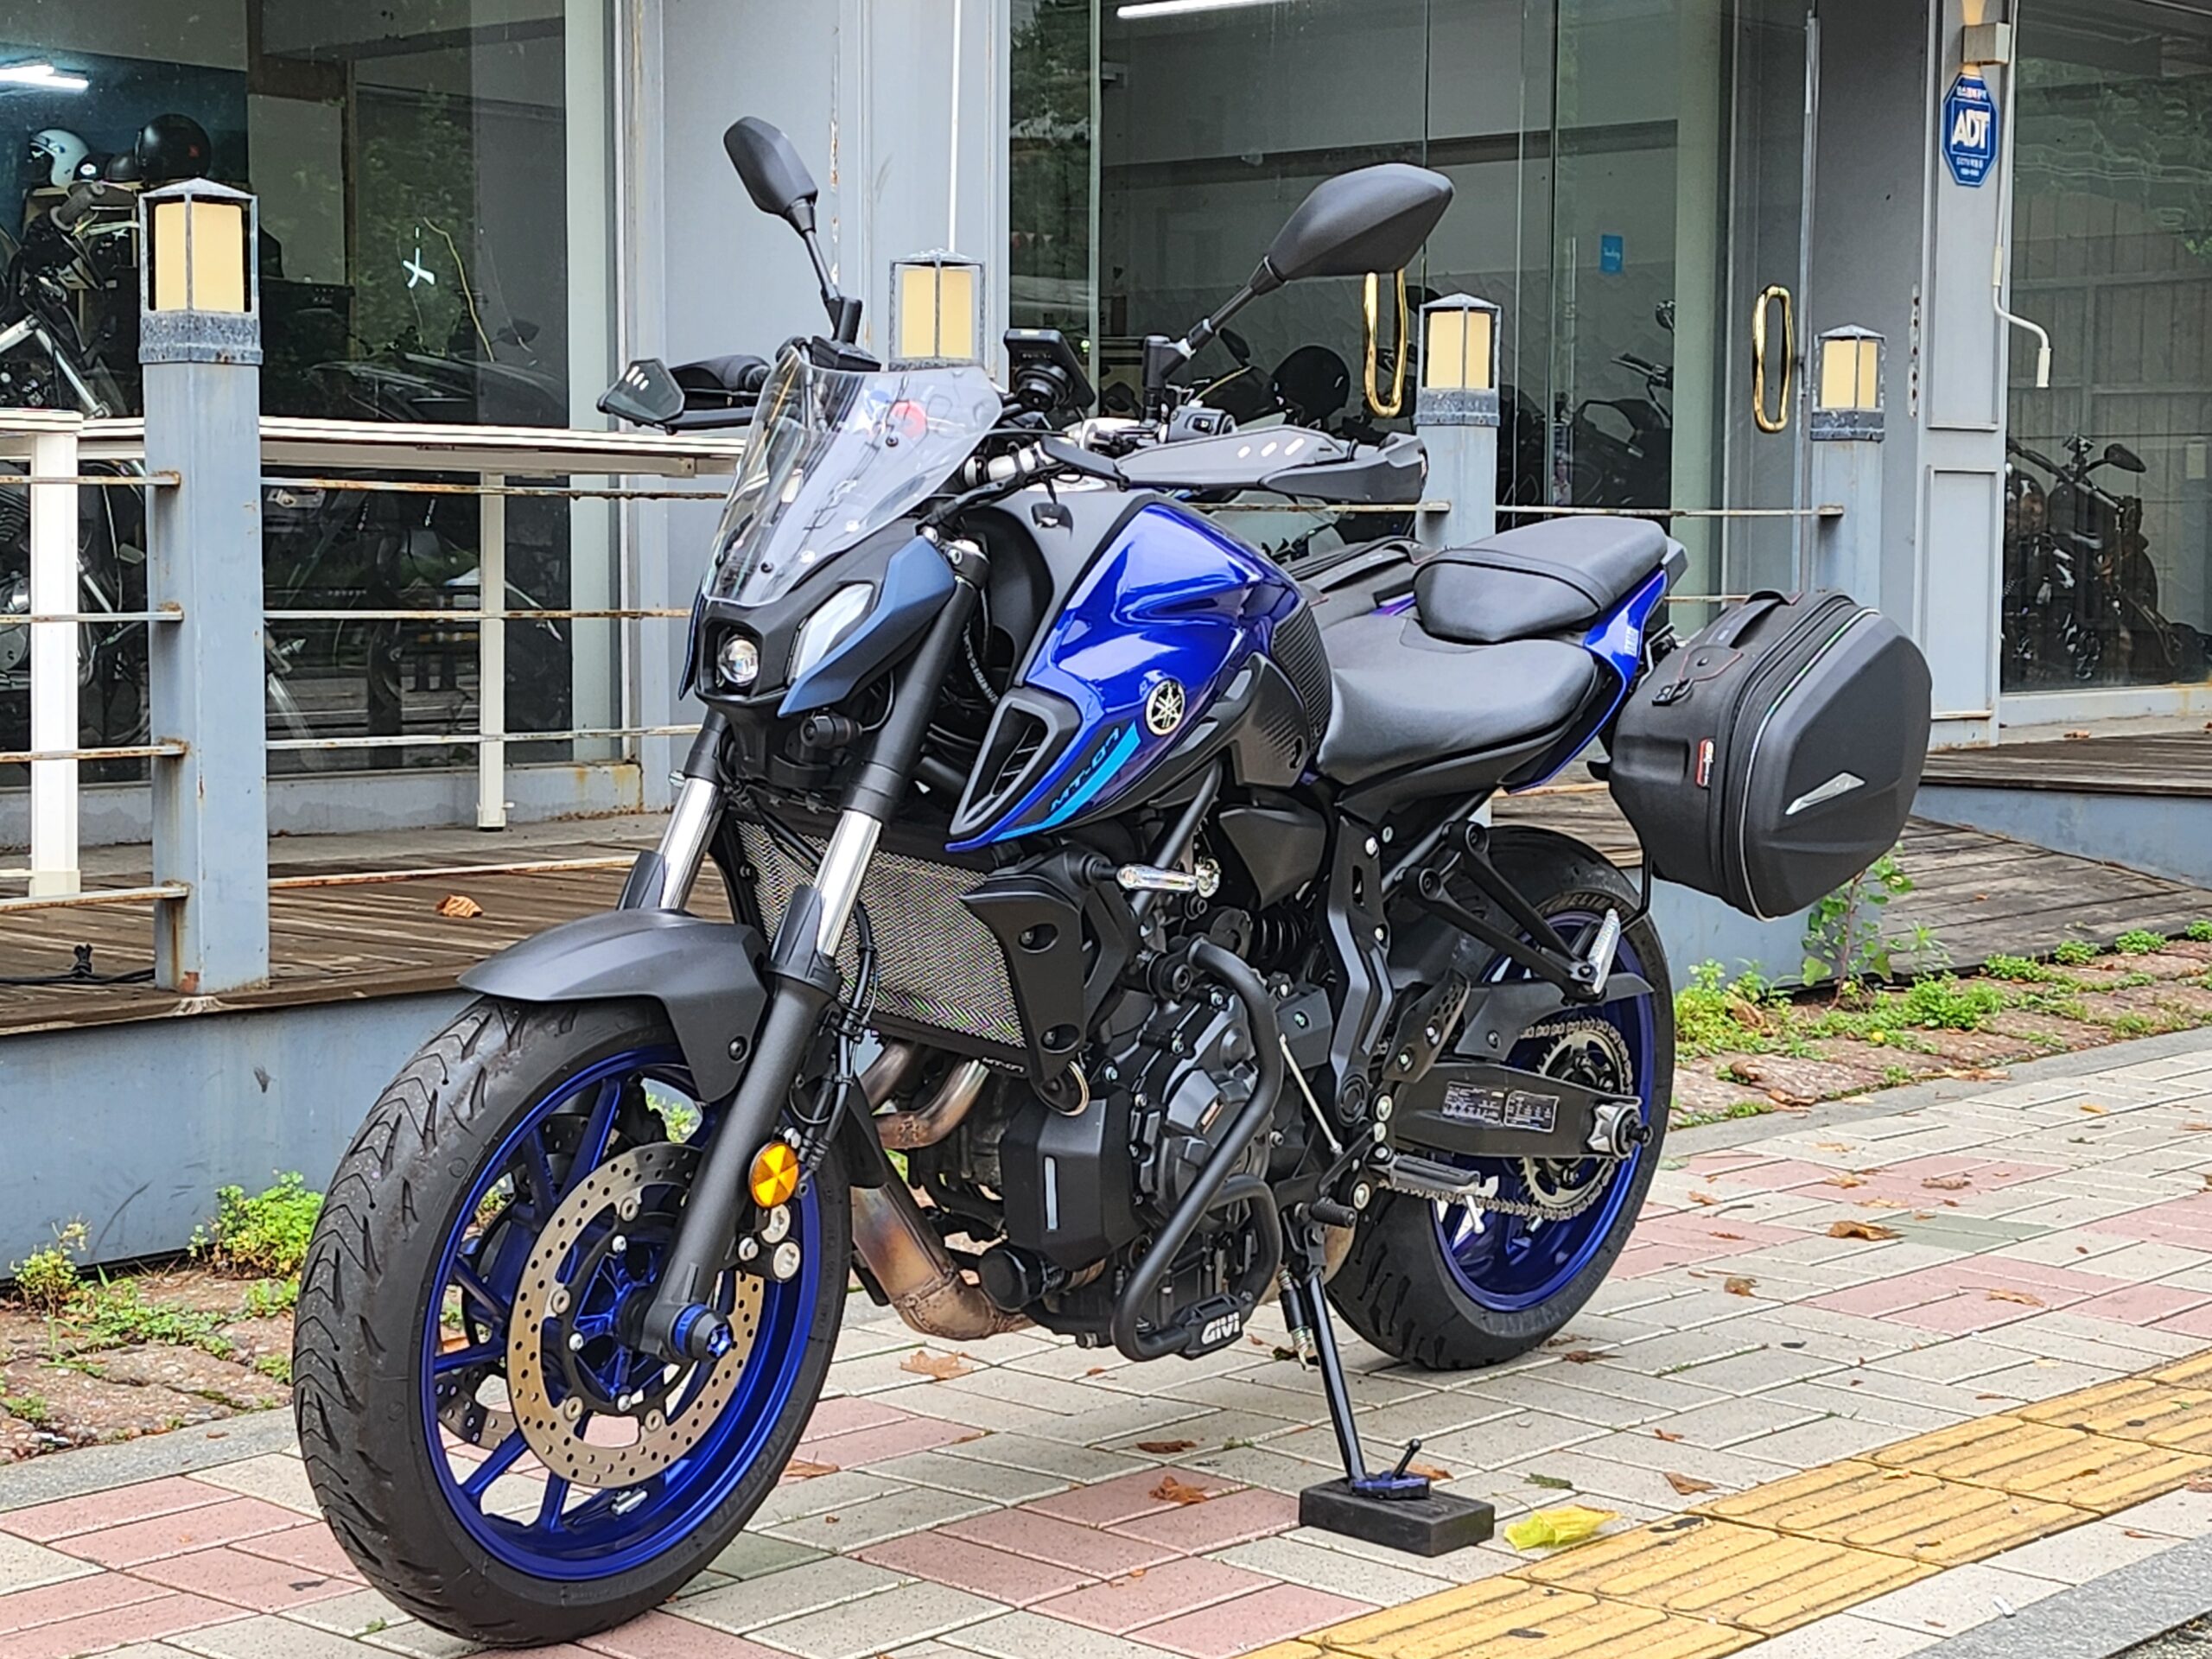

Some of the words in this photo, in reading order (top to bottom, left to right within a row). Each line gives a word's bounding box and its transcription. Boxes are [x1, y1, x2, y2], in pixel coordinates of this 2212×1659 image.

[1952, 109, 1991, 149] ADT
[1050, 728, 1119, 811] MT-07
[1201, 1312, 1240, 1344] GIVI
